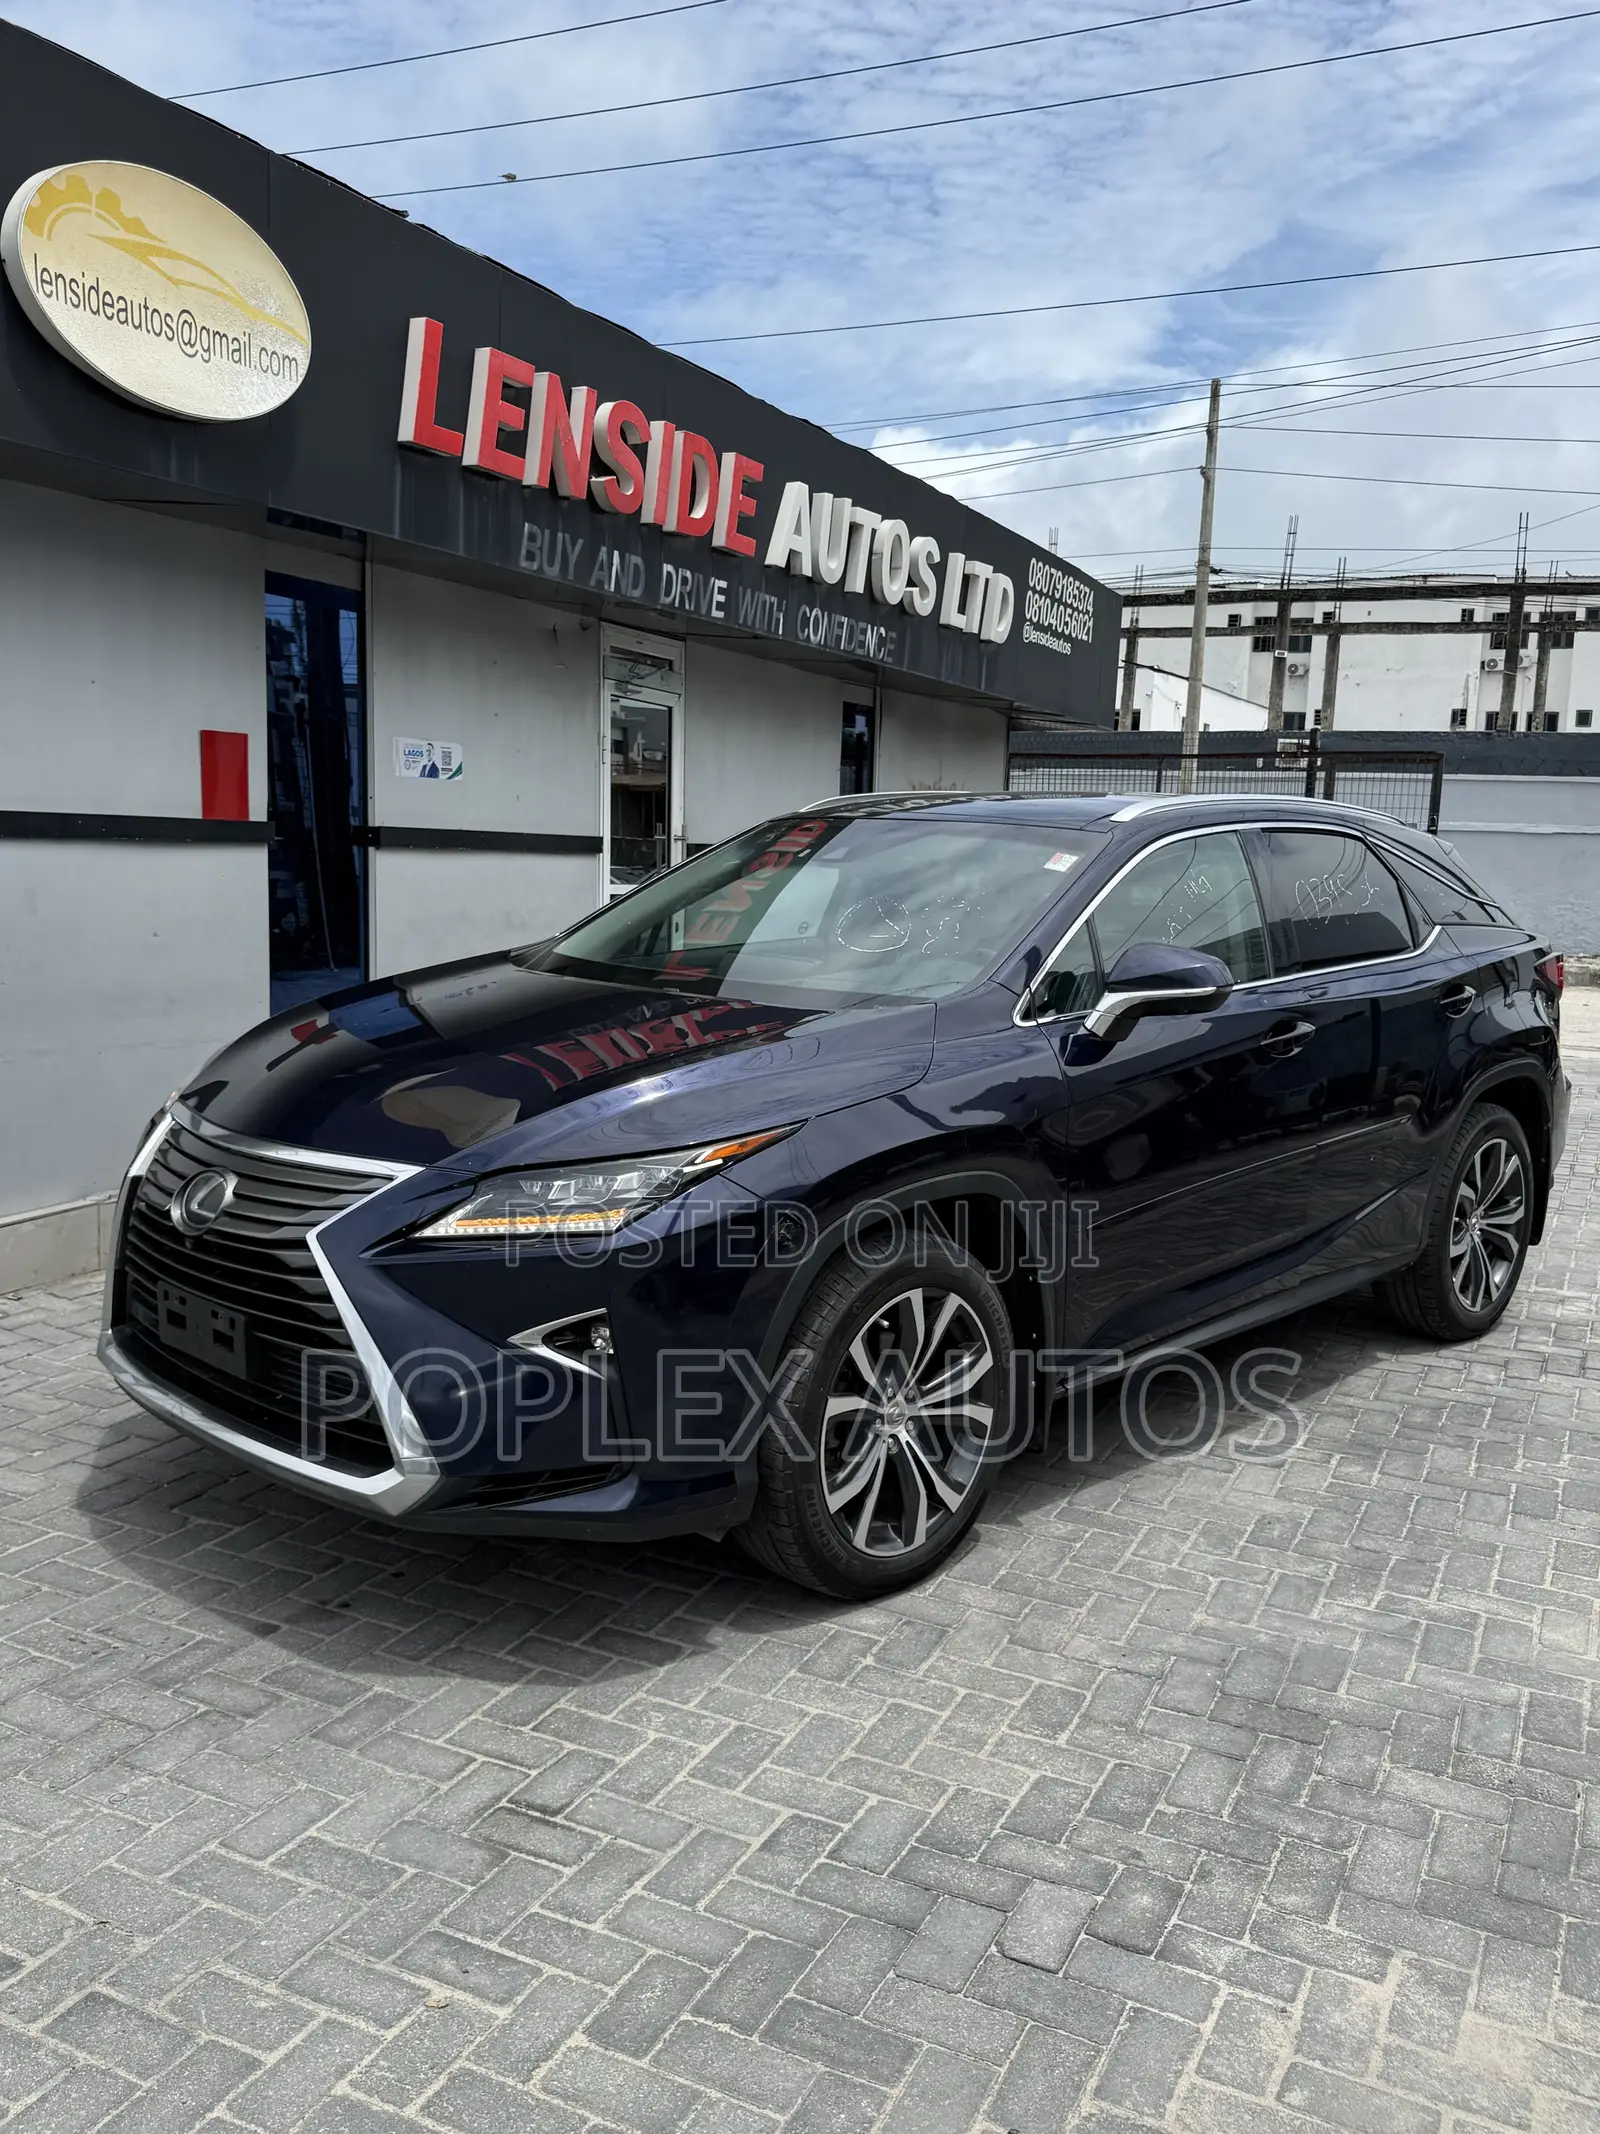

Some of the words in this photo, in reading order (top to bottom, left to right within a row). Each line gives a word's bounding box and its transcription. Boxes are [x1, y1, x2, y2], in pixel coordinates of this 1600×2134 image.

[33, 252, 300, 383] lensideautos@gmail.com
[397, 316, 765, 557] LENSIDE
[764, 481, 941, 618] AUTOS
[939, 552, 1015, 645] LTD
[518, 521, 584, 581] BUY
[589, 545, 646, 599] AND
[658, 562, 728, 620] DRIVE
[738, 585, 788, 636] WITH
[796, 603, 898, 664] CONFIDENCE
[1025, 589, 1094, 643] 08104056021
[1028, 557, 1094, 617] 08079185374
[1022, 621, 1072, 655] @lensideautos
[403, 749, 424, 757] LAGOS
